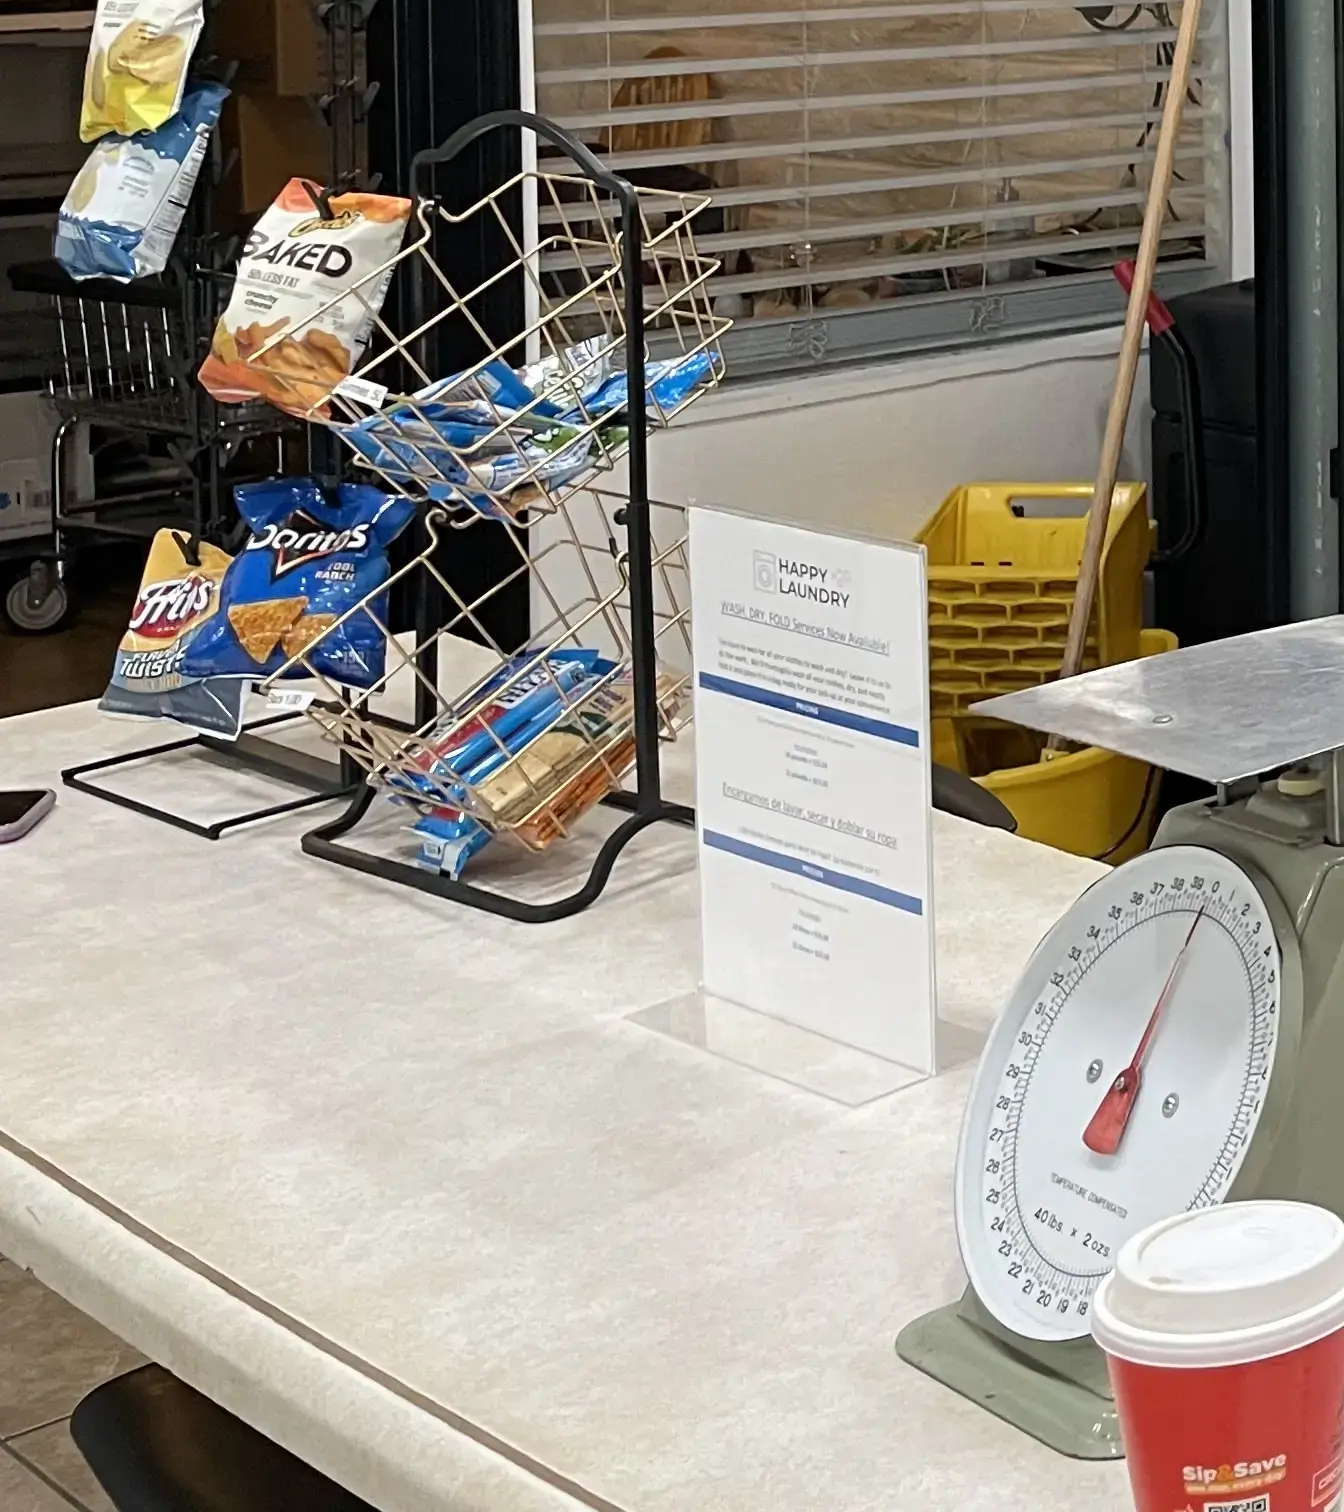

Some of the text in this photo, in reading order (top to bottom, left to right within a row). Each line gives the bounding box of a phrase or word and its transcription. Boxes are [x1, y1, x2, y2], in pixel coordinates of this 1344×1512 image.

[245, 522, 371, 552] Doritos
[778, 557, 828, 584] HAPPY
[778, 578, 850, 609] LAUNDRY
[768, 611, 791, 629] FOLD
[792, 617, 825, 637] Services
[827, 626, 847, 643] Now
[770, 797, 782, 810] de
[806, 809, 829, 826] secar
[866, 827, 876, 840] su
[876, 831, 898, 849] ropa
[1150, 881, 1165, 896] 37
[1170, 877, 1185, 891] 38
[1210, 880, 1221, 894] 0
[1240, 903, 1251, 917] 2
[1252, 921, 1262, 935] 3
[1263, 945, 1273, 958] 4
[1018, 1031, 1033, 1047] 30
[996, 1095, 1011, 1111] 28
[988, 1127, 1005, 1143] 27
[985, 1188, 1001, 1205] 25
[1050, 1171, 1129, 1220] TEMPERATURE COMPENSATED
[990, 1216, 1006, 1233] 24
[1070, 1226, 1078, 1238] x
[998, 1239, 1013, 1257] 23
[1007, 1261, 1023, 1279] 22
[1021, 1278, 1035, 1296] 21
[1036, 1289, 1052, 1308] 20
[1056, 1298, 1070, 1315] 19
[1076, 1300, 1089, 1316] 18
[1181, 1452, 1288, 1485] Sip&Save
